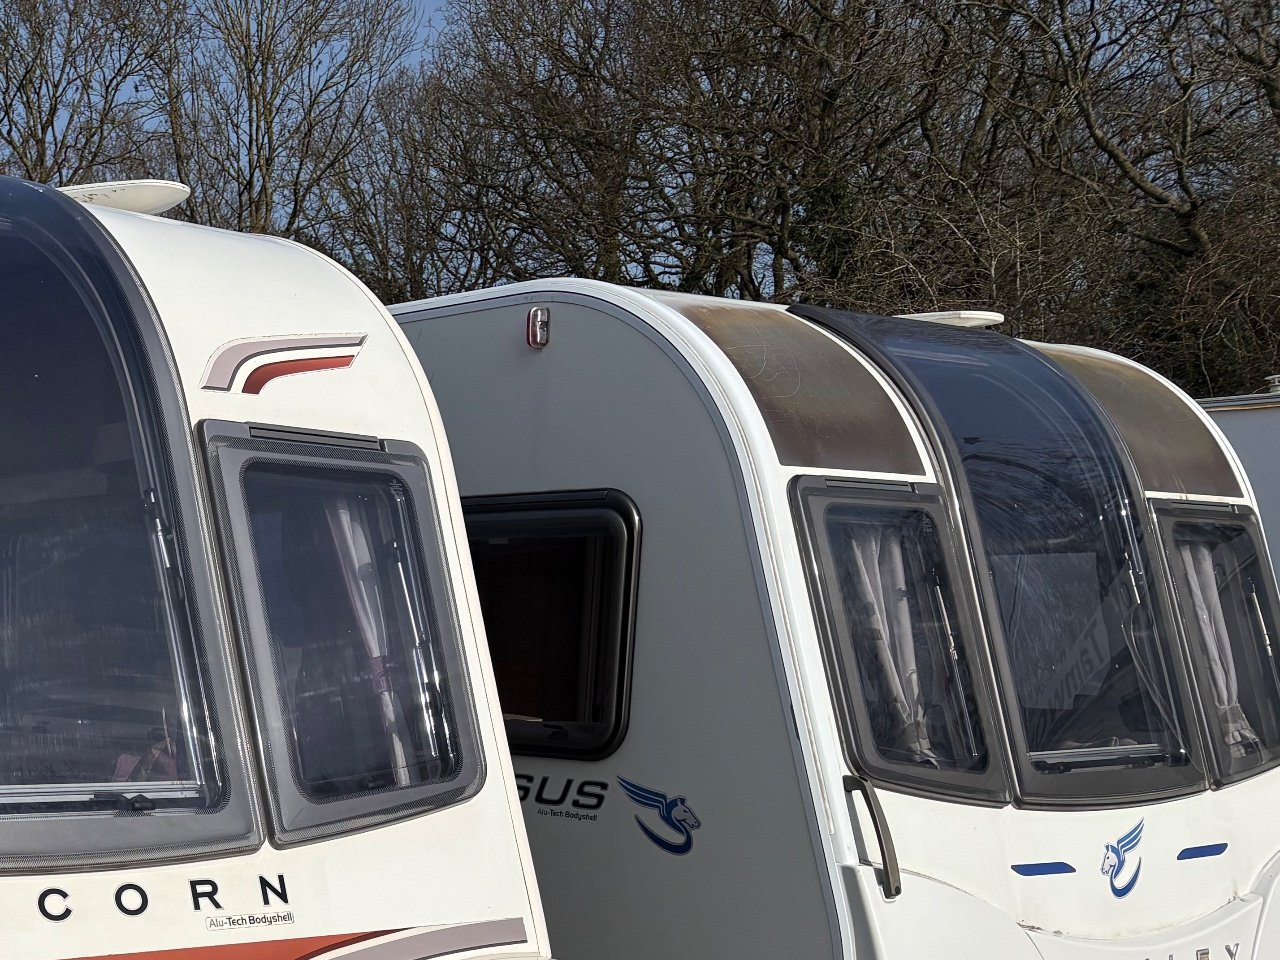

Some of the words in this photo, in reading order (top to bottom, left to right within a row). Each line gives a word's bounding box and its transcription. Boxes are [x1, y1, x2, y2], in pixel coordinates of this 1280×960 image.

[537, 808, 564, 818] Alu-Tech
[564, 810, 598, 821] Bodyshell
[209, 916, 248, 928] Alu-Tech
[248, 912, 293, 926] Bodyshell
